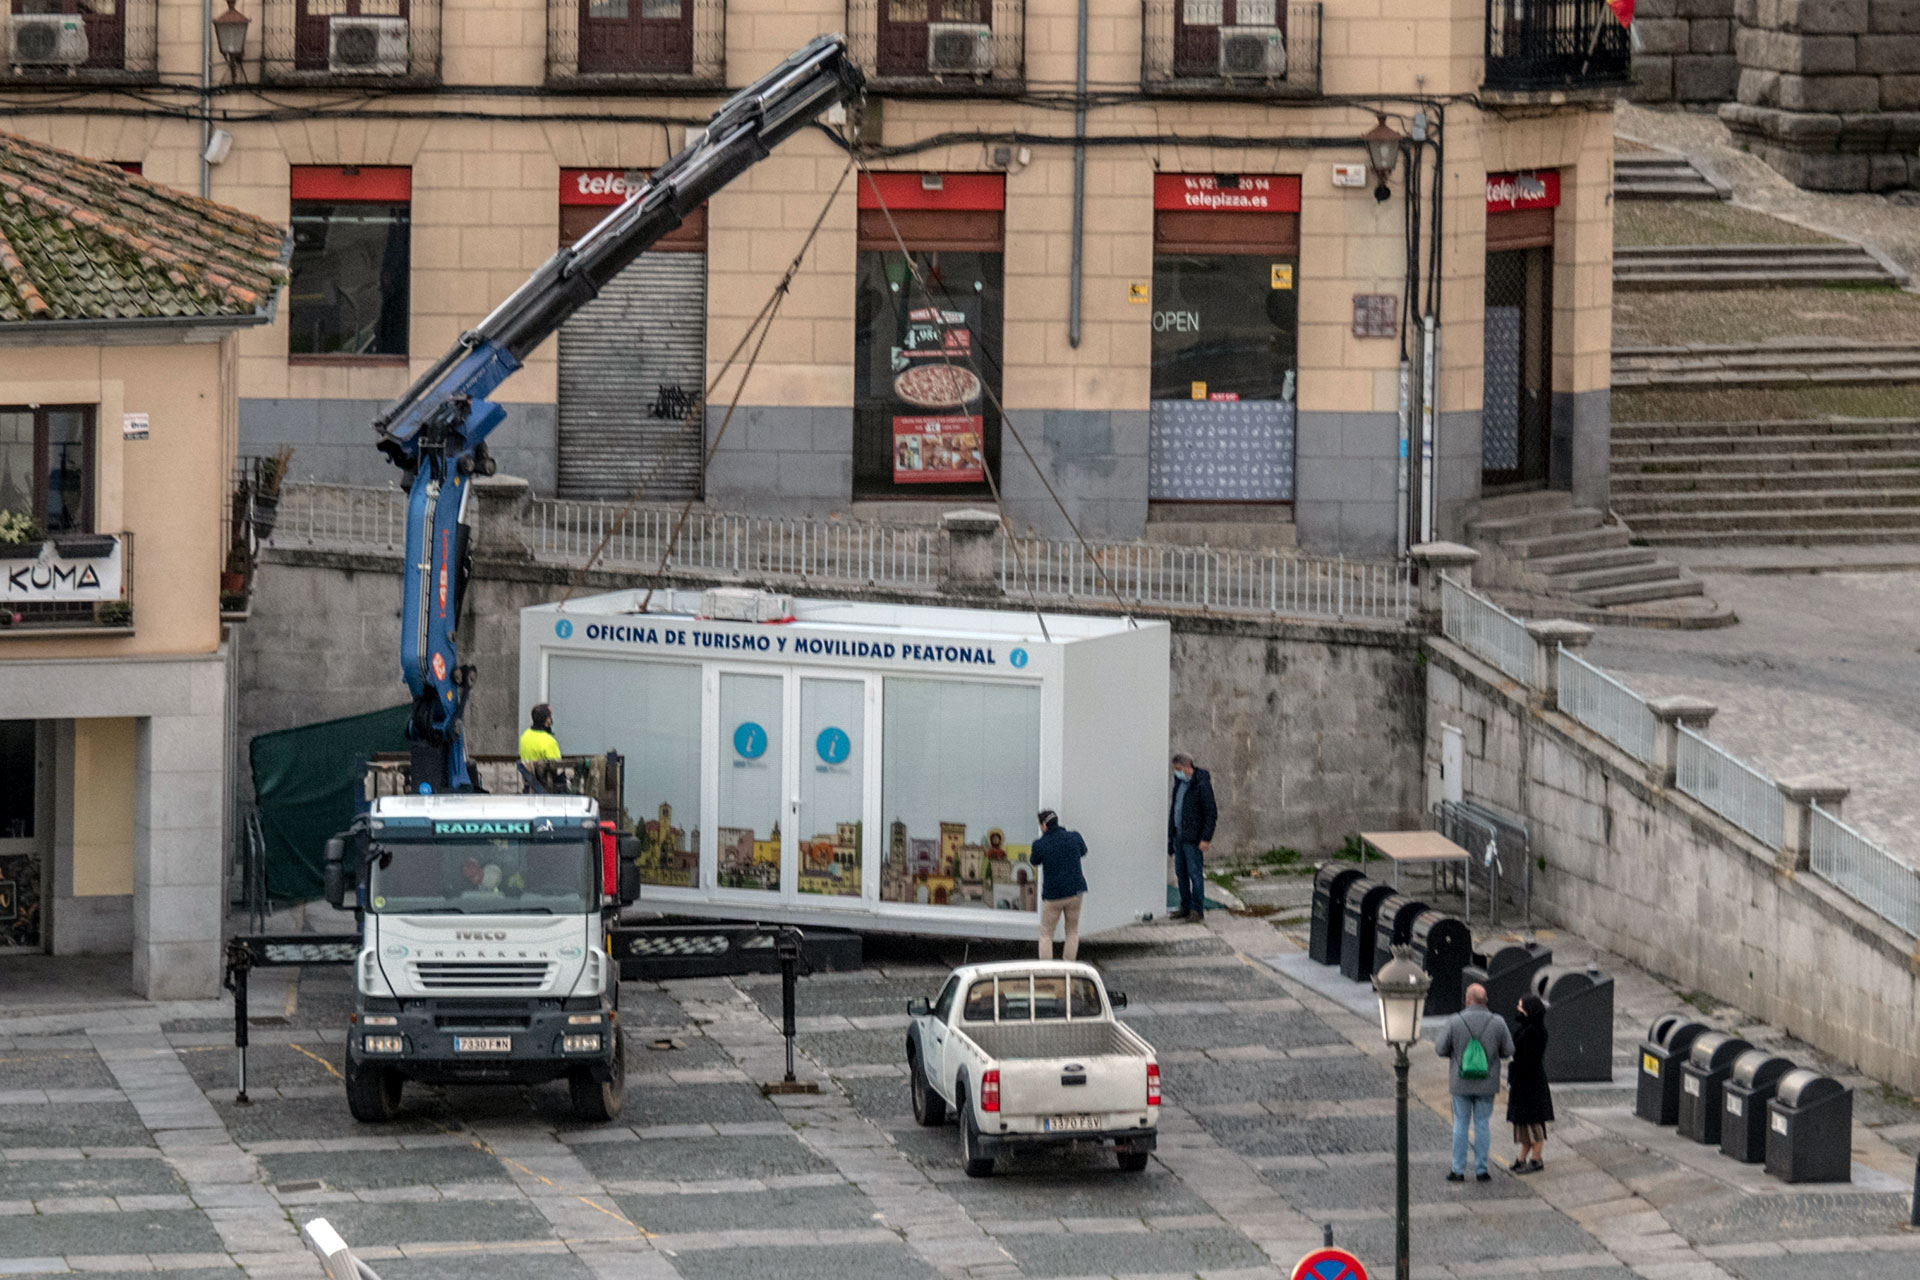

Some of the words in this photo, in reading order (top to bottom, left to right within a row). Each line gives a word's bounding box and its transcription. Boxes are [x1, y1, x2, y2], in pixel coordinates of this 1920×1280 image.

[1185, 191, 1268, 209] telepizza.es
[1152, 311, 1199, 332] OPEN
[586, 624, 658, 644] OFICINA
[664, 629, 687, 646] DE
[692, 631, 770, 651] TURISMO
[776, 637, 788, 652] Y
[794, 637, 896, 658] MOVILIDAD
[902, 643, 996, 665] PEATONAL
[434, 822, 531, 834] RADALKI
[456, 930, 507, 941] IVECO
